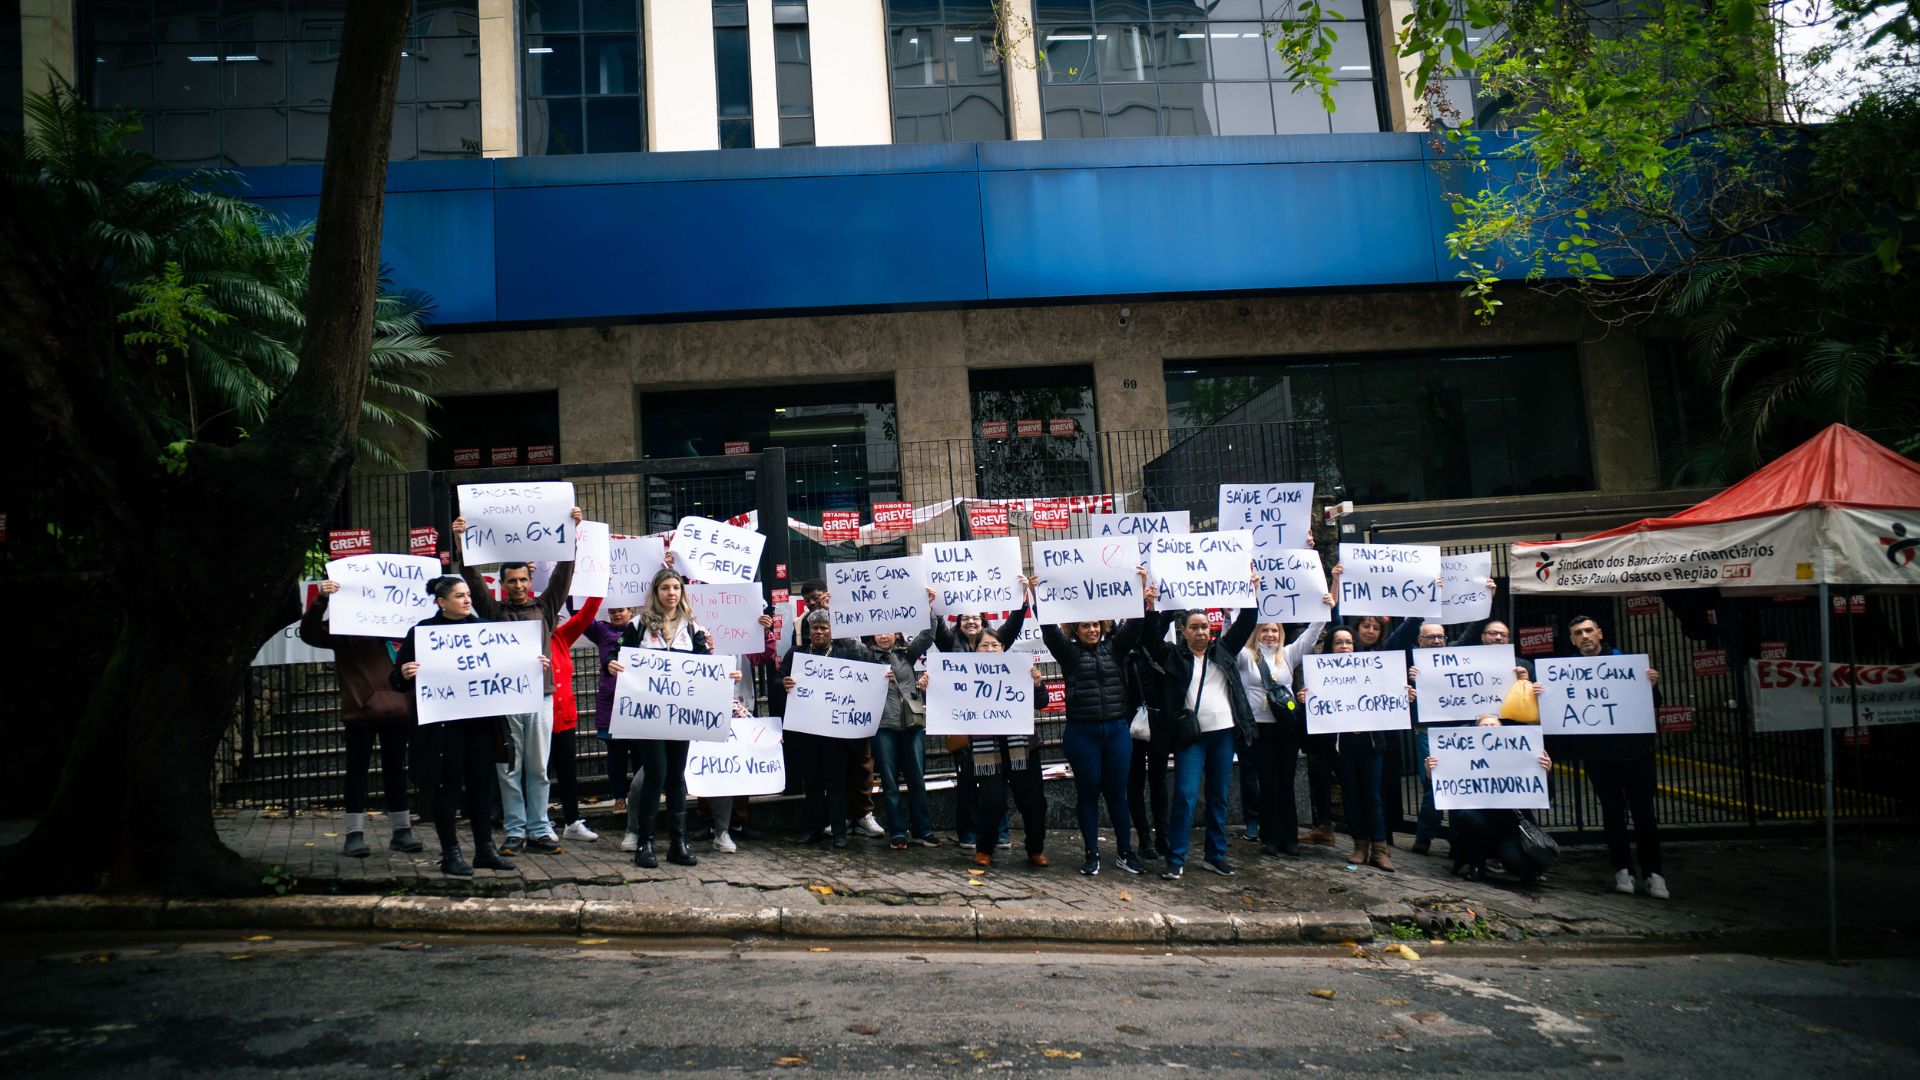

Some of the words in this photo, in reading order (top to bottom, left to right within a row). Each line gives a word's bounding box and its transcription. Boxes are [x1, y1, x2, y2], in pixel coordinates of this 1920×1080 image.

[1123, 378, 1137, 390] 69
[1018, 424, 1041, 433] GREVE
[528, 449, 554, 459] GREVE
[1267, 487, 1302, 504] CAIXA
[482, 504, 522, 515] APOIAM
[527, 504, 536, 515] O
[1069, 495, 1112, 514] EVE
[874, 509, 912, 523] GREVE
[970, 513, 1008, 527] GREVE
[1033, 509, 1068, 521] GREVE
[1245, 507, 1253, 522] É
[1260, 507, 1281, 522] NO
[822, 518, 859, 531] GREVE
[1101, 523, 1113, 536] A
[1117, 516, 1170, 535] CAIXA
[330, 536, 371, 550] GREVE
[410, 535, 437, 549] REVE
[465, 525, 496, 550] FIM
[505, 532, 521, 543] DA
[683, 524, 702, 540] SE
[710, 530, 720, 545] É
[722, 538, 751, 555] GRAVE
[1243, 523, 1287, 547] CT
[610, 547, 628, 561] UM
[1157, 538, 1194, 554] SAÚDE
[1200, 537, 1243, 553] CAIXA
[934, 547, 974, 563] LULA
[1043, 548, 1084, 567] FORA
[1252, 554, 1285, 571] AÚDE
[1352, 546, 1421, 563] BANCÁRIOS
[1557, 556, 1605, 572] Sindicato
[1606, 556, 1626, 569] dos
[1628, 551, 1678, 567] Bancários
[1680, 553, 1688, 562] e
[1690, 543, 1775, 562] Financiários
[376, 561, 424, 580] VOLTA
[609, 563, 640, 575] EITO
[699, 552, 752, 580] GREVE
[1186, 558, 1208, 572] NA
[835, 568, 871, 584] SAÚDE
[875, 565, 910, 580] CAIXA
[931, 570, 978, 583] PROTEJA
[987, 566, 1002, 581] OS
[1557, 575, 1569, 586] de
[1571, 573, 1588, 586] São
[1589, 571, 1619, 585] Paulo,
[1620, 569, 1661, 583] Osasco
[1664, 571, 1673, 580] e
[1673, 564, 1718, 583] Região
[1038, 580, 1079, 602] CARLOS
[1083, 578, 1133, 600] VIEIRA
[1157, 578, 1255, 602] APOSENTADORIA
[1260, 575, 1268, 592] É
[1274, 576, 1296, 591] NO
[1342, 581, 1371, 602] FIM
[1382, 585, 1398, 598] DA
[362, 586, 376, 599] DO
[384, 585, 427, 607] 70/30
[718, 592, 747, 605] TETO
[851, 585, 877, 602] NÃO
[882, 585, 890, 600] É
[943, 585, 1012, 606] BANCÁRIOS
[1832, 594, 1866, 607] GRVE
[834, 611, 864, 625] PLANO
[869, 605, 917, 623] PRIVADO
[430, 631, 472, 650] SAÚDE
[478, 628, 520, 646] CAIXA
[1520, 632, 1553, 647] GREVE
[457, 652, 490, 670] SEM
[630, 653, 672, 671] SAÚDE
[681, 660, 726, 681] CAIXA
[942, 659, 968, 674] PELA
[974, 662, 1011, 675] VOLTA
[1316, 655, 1383, 669] BANCÁRIOS
[1432, 653, 1459, 667] FIM
[1694, 655, 1726, 669] GREVE
[839, 666, 869, 683] CAXA
[1444, 671, 1484, 688] TETO
[1548, 664, 1593, 681] SAÚDE
[1596, 662, 1637, 681] CAIXA
[421, 685, 455, 701] FAIXA
[468, 673, 532, 697] ETÁRIA
[648, 673, 681, 696] NÃO
[687, 680, 696, 696] É
[1323, 675, 1357, 686] APOIAM
[1364, 675, 1372, 684] A
[825, 691, 856, 706] FAIXA
[953, 682, 967, 692] DO
[973, 680, 1025, 702] 70/30
[1471, 693, 1503, 705] CAIXA
[1566, 683, 1576, 699] É
[1585, 686, 1610, 700] NO
[620, 696, 661, 719] PLANO
[665, 703, 724, 730] PRIVADO
[1308, 695, 1343, 716] GREVE
[1357, 694, 1409, 712] CORREIOS
[831, 708, 872, 726] ETÁRIA
[952, 708, 979, 721] SAÚDE
[983, 709, 1012, 720] CAIXA
[1562, 703, 1618, 728] ACT
[1437, 732, 1475, 750] SAÚDE
[1481, 733, 1532, 751] CAIXA
[690, 755, 740, 775] CARLOS
[745, 757, 781, 774] VIEIRA
[1470, 758, 1490, 770] NA
[1435, 775, 1545, 797] APOSENTADORIA
